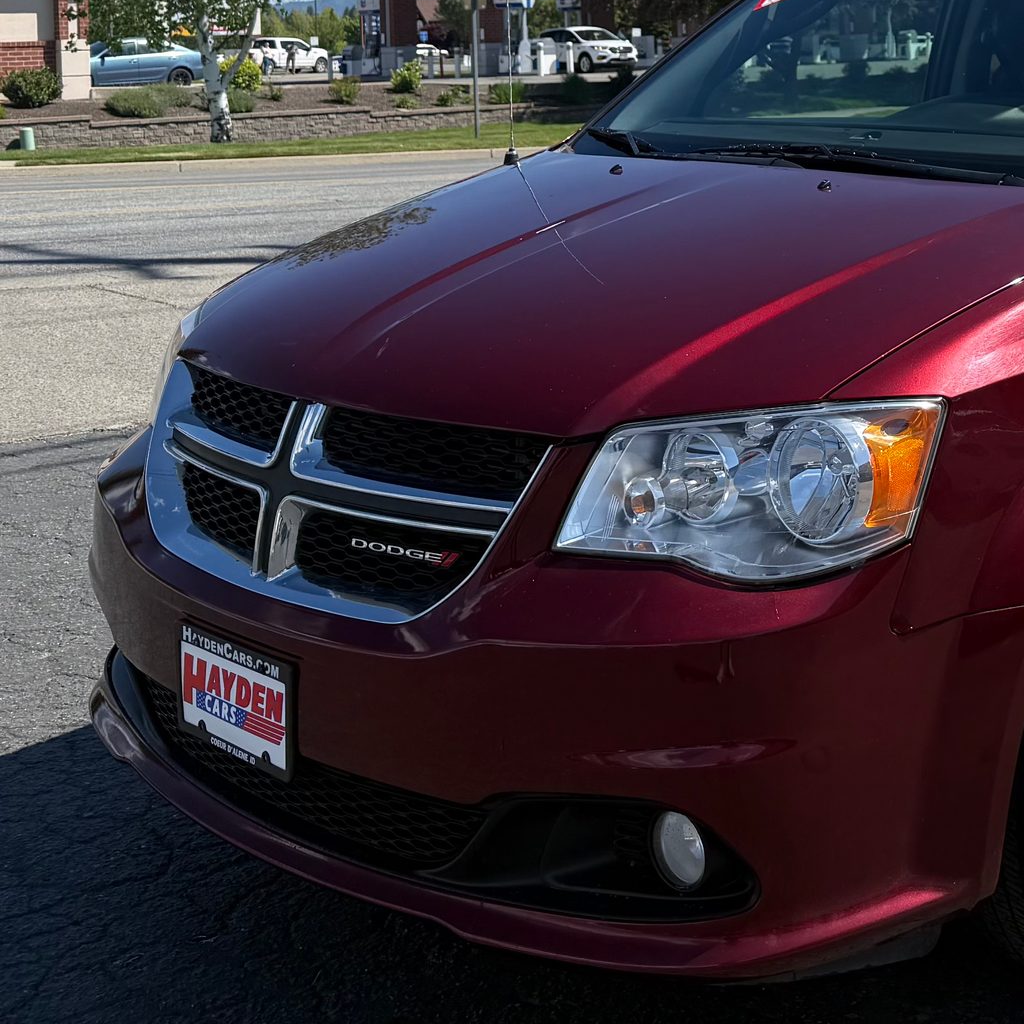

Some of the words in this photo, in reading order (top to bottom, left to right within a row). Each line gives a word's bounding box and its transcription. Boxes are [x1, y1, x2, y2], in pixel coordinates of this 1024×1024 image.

[351, 538, 443, 563] DODGE
[183, 652, 284, 724] HAYDEN
[204, 696, 237, 725] CARS
[210, 736, 227, 752] COEUR
